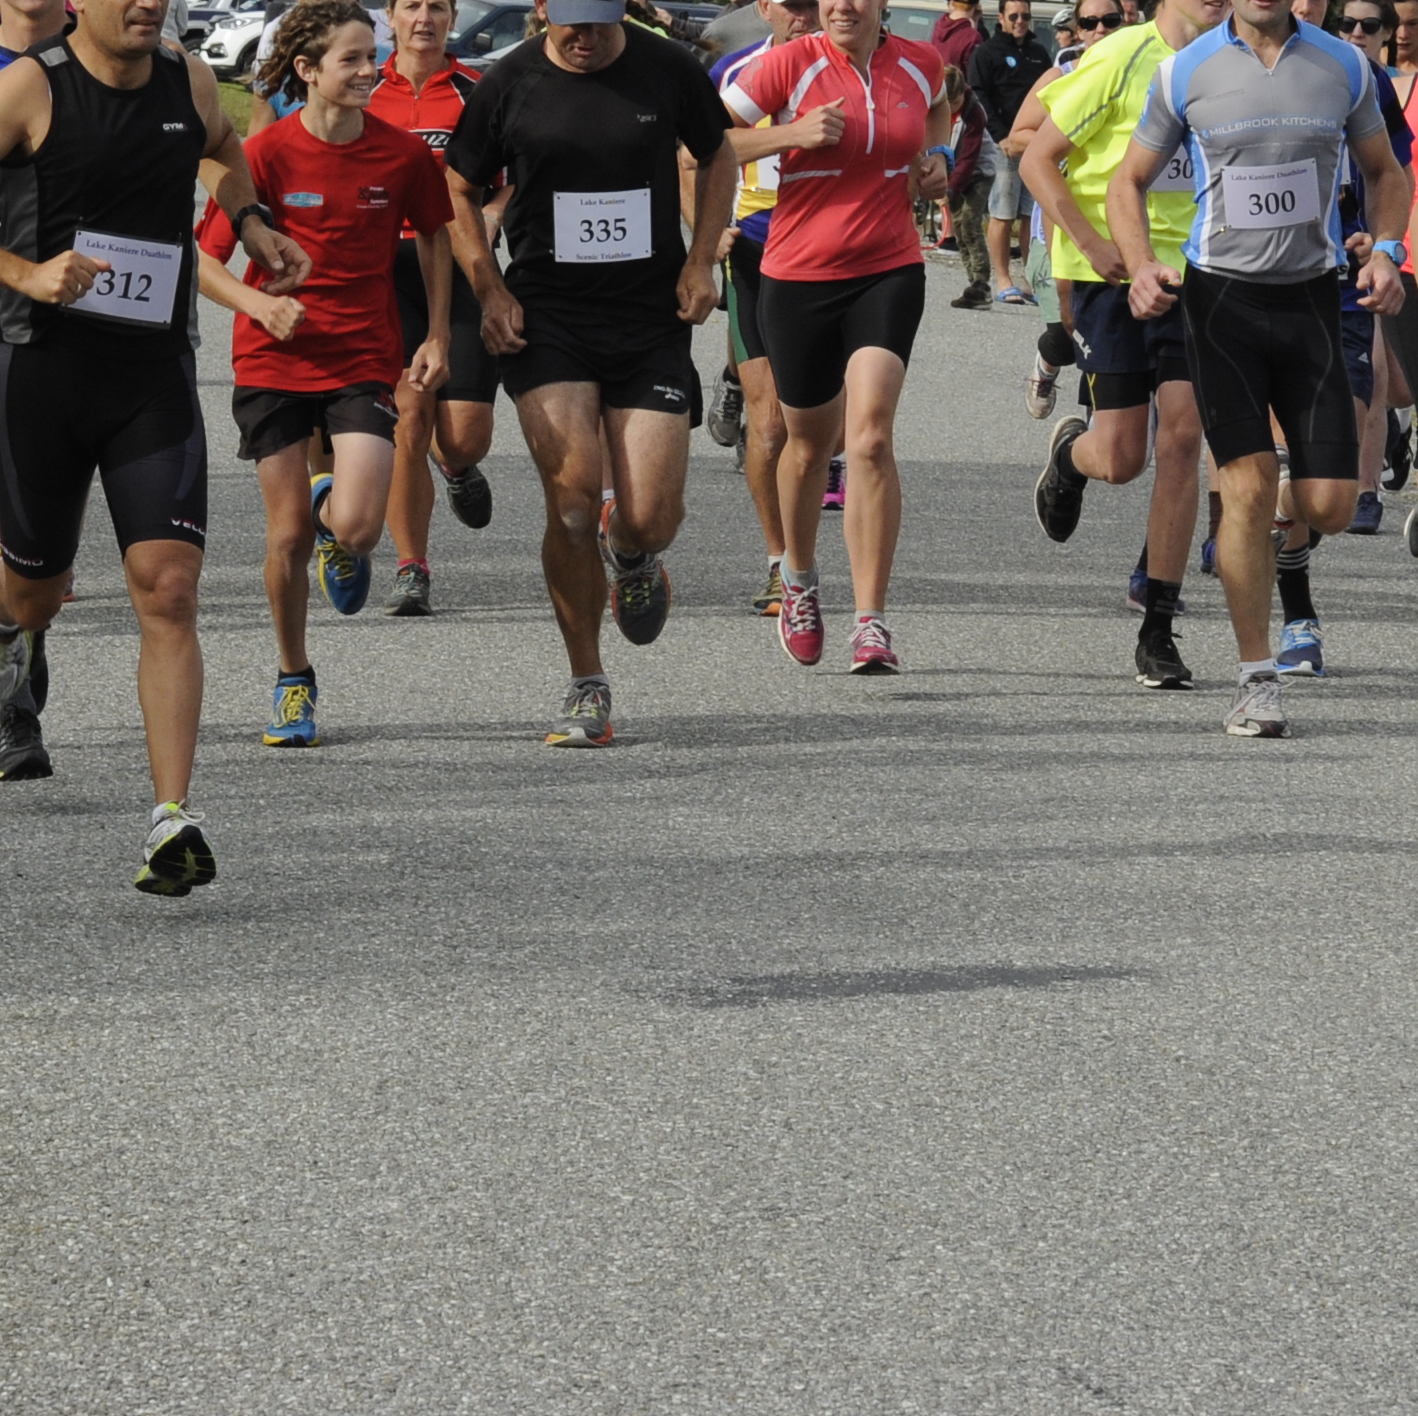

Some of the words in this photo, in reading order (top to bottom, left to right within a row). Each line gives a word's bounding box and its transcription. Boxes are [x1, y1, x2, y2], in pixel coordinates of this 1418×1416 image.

[1209, 117, 1279, 137] MILLBROOK
[1282, 116, 1337, 129] KITCHENS
[1248, 173, 1275, 181] Kaniere
[1277, 167, 1308, 179] Duathlon
[580, 198, 597, 206] Lake
[1248, 189, 1296, 216] 300
[579, 217, 627, 243] 335
[86, 239, 106, 250] Lake
[108, 243, 140, 256] Kaniere
[141, 248, 173, 260] Duathlon
[576, 253, 599, 261] Scenic
[601, 252, 632, 260] Triathlon
[96, 268, 153, 303] 312
